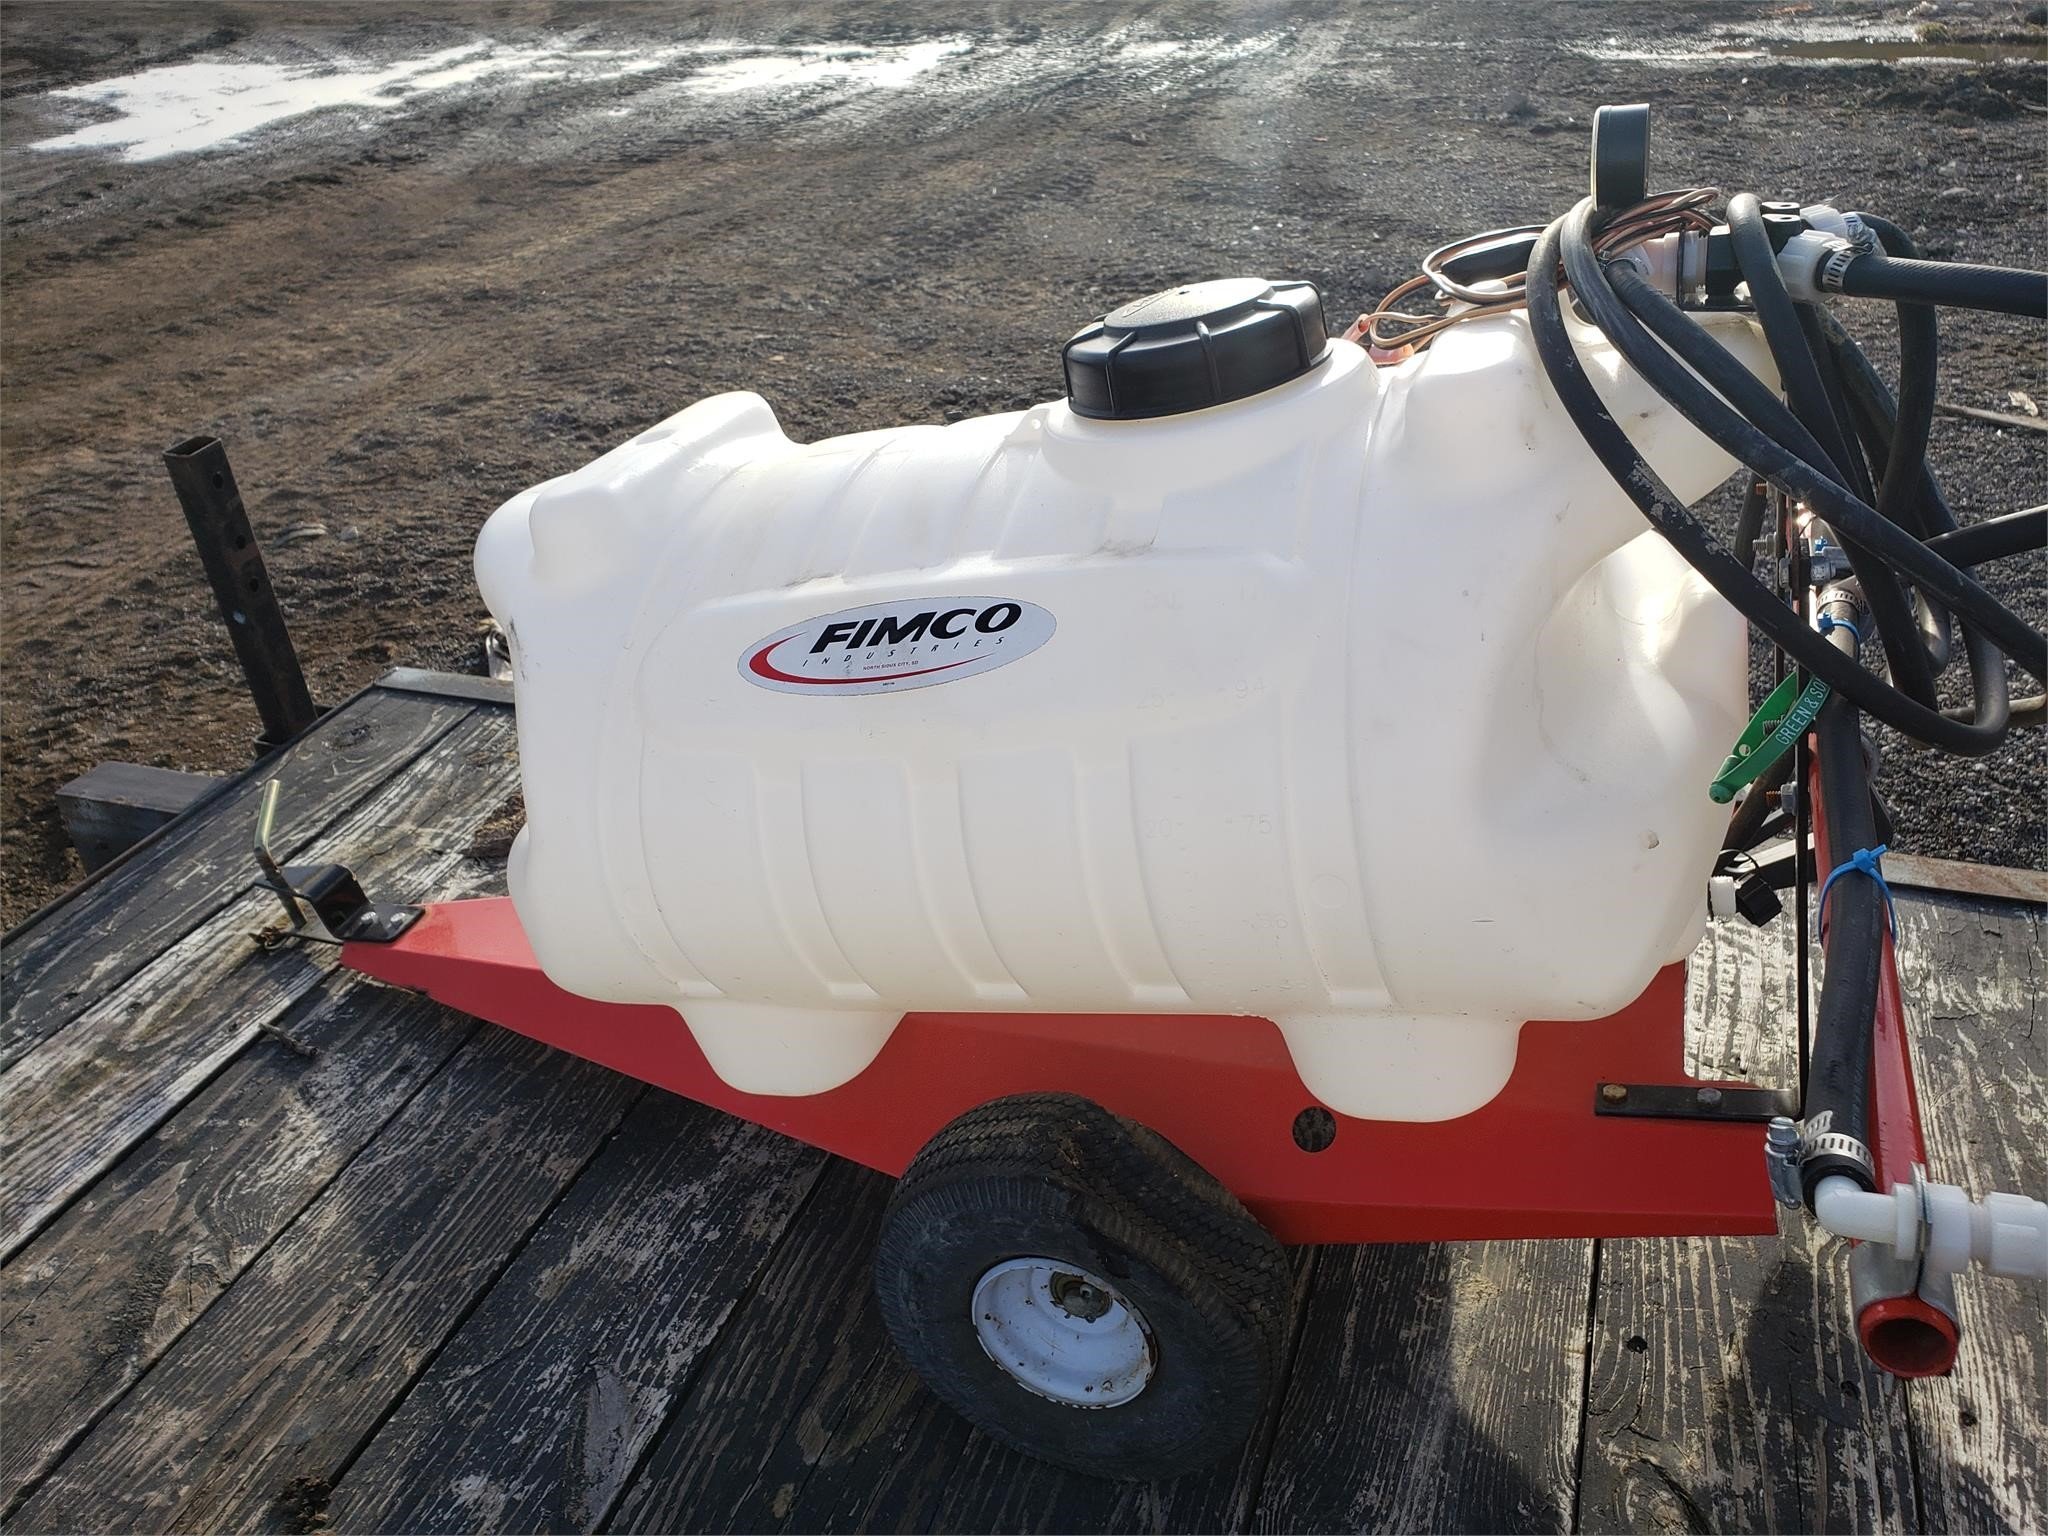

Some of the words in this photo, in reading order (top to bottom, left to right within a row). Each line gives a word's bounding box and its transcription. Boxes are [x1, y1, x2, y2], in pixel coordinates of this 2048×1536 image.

[803, 636, 1004, 667] INDUSTRIES
[809, 603, 1021, 654] FIMCO
[1775, 706, 1812, 745] GREEN
[1804, 697, 1819, 709] &
